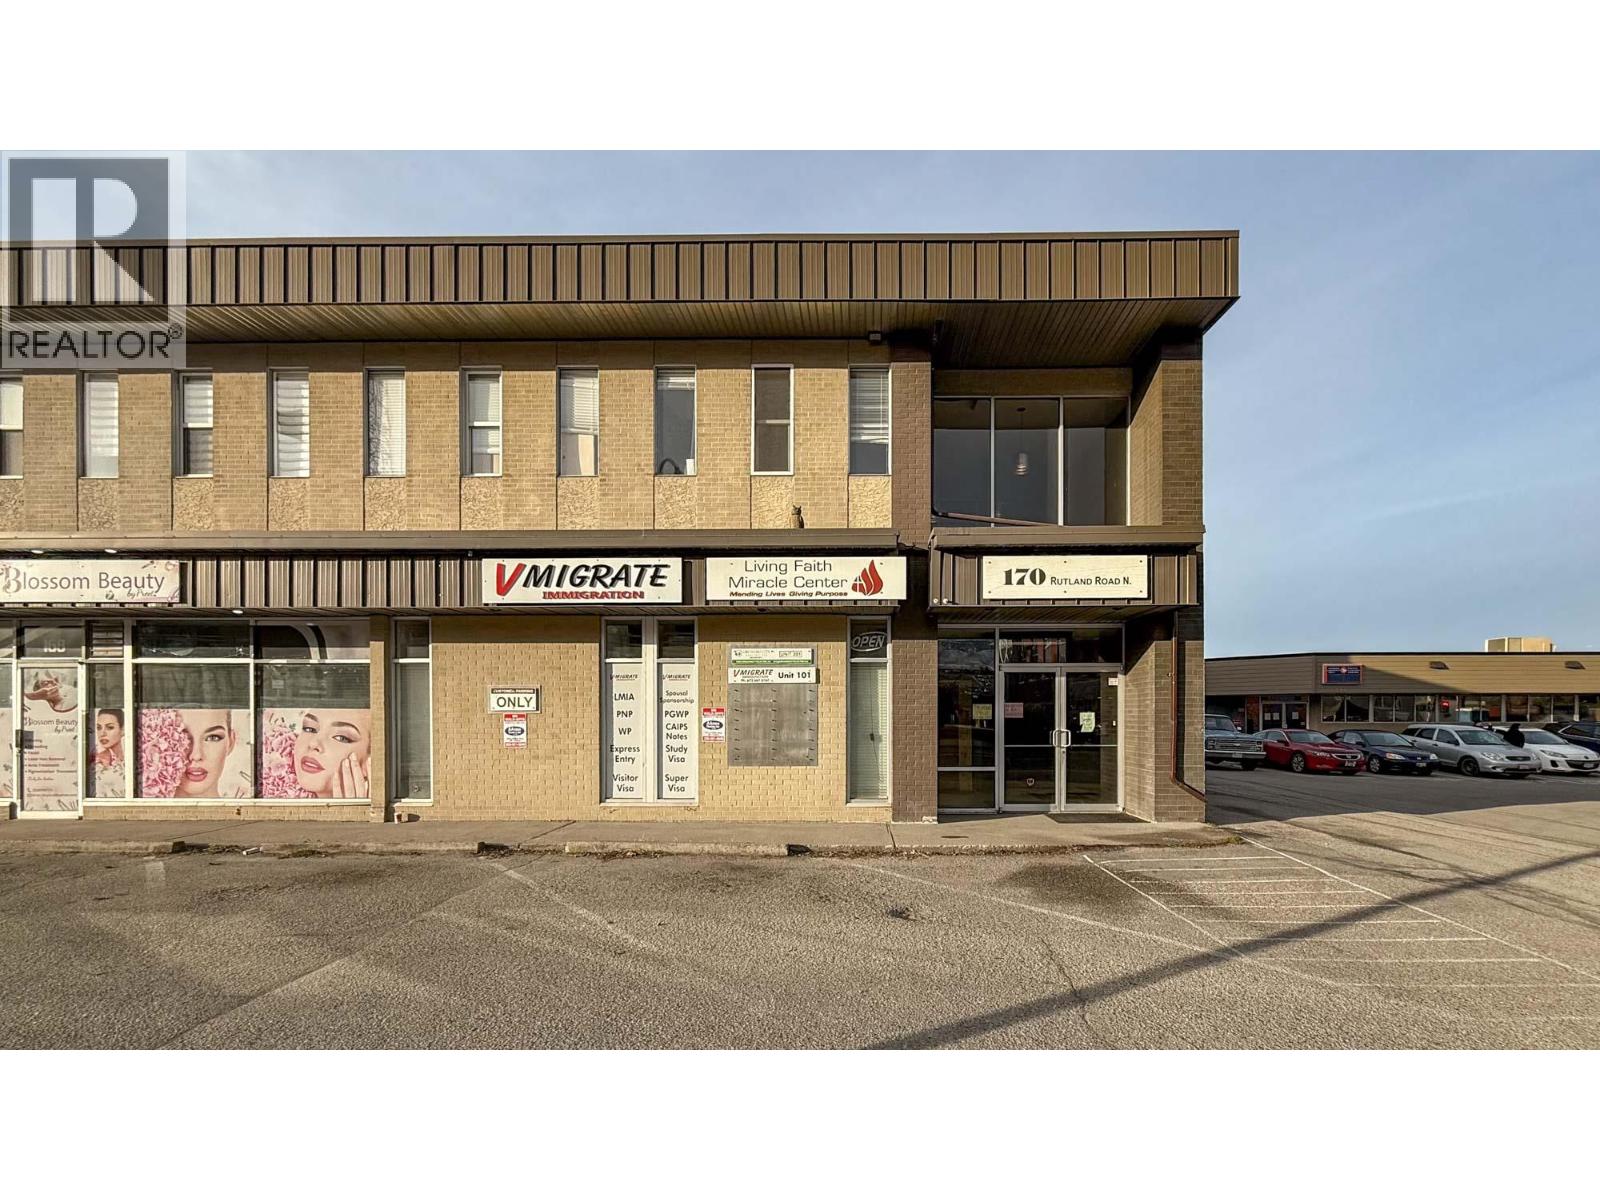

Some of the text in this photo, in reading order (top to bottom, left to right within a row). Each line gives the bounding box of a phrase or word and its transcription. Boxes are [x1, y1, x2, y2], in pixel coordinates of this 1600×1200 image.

[744, 560, 832, 575] Living Faith
[3, 565, 165, 594] Blossom Beauty
[1003, 568, 1132, 586] 170 RUTLAND ROAD N.
[728, 577, 848, 589] Miracle Center
[542, 591, 645, 599] IMMIGRATION
[852, 634, 885, 648] OPEN
[614, 693, 635, 701] LMIA
[496, 696, 533, 708] ONLY
[616, 710, 633, 718] PNP
[664, 710, 690, 718] PGWP
[665, 732, 688, 740] Notes
[610, 744, 641, 754] Express
[665, 744, 688, 754] Study
[615, 755, 636, 764] Entry
[664, 774, 689, 783] Super
[617, 784, 635, 792] Visa
[668, 784, 686, 792] Visa
